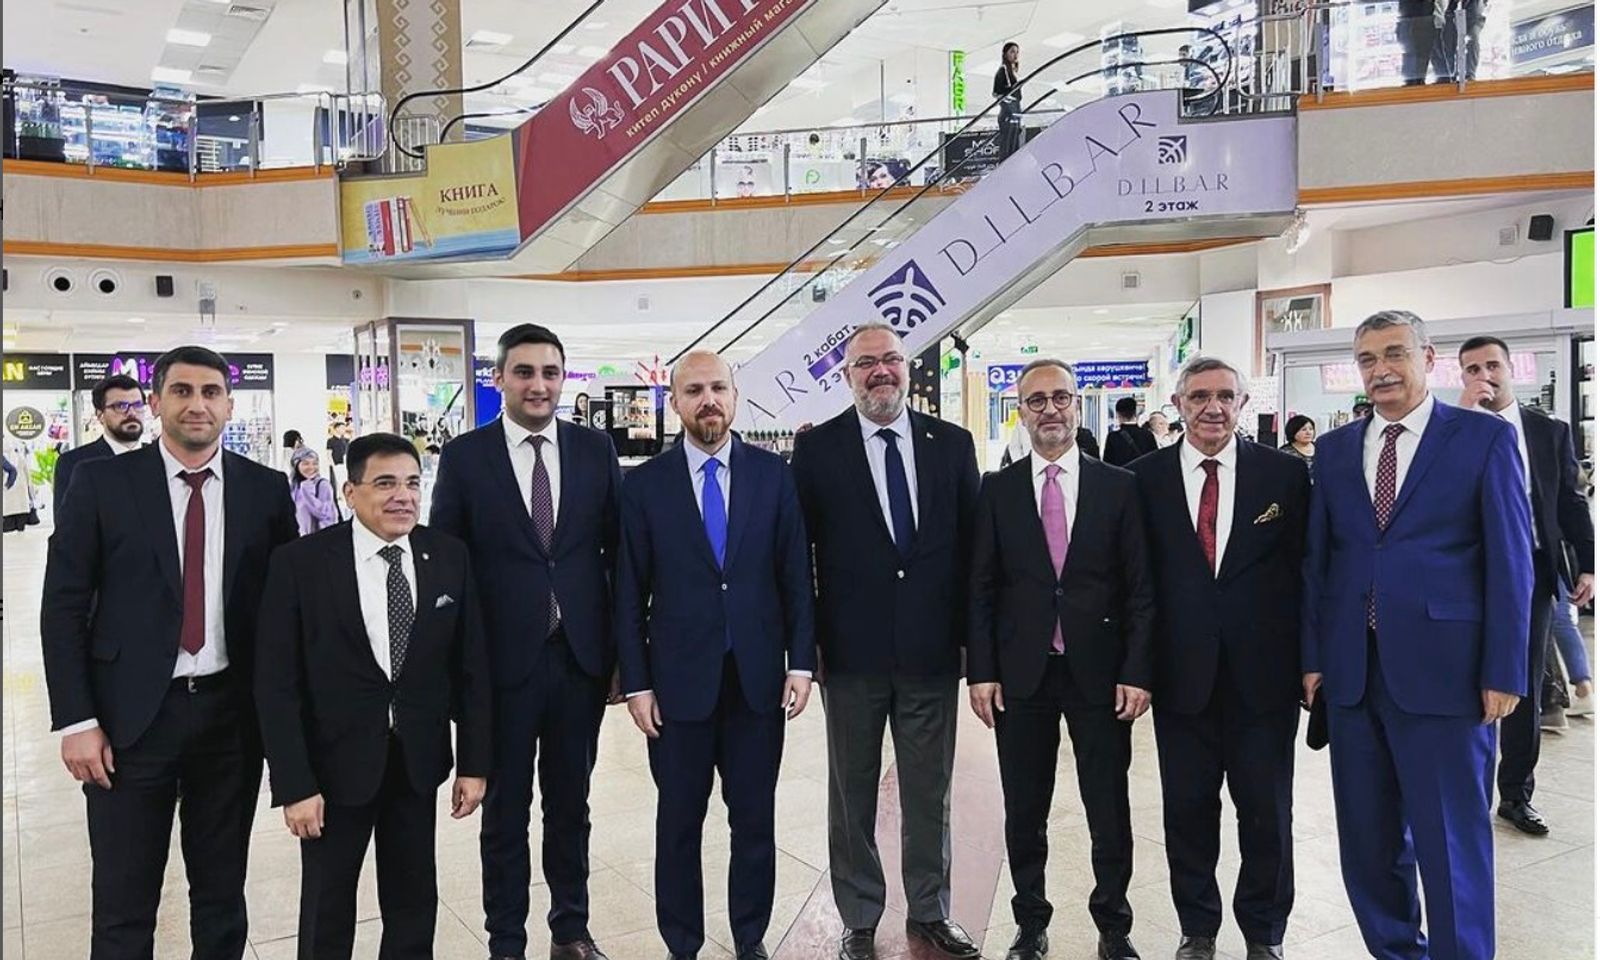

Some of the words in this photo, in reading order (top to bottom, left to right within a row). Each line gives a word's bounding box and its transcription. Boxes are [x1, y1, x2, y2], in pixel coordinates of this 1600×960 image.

[625, 108, 660, 138] китеп
[709, 18, 763, 69] книжный
[439, 183, 499, 203] КНИГА
[938, 102, 1156, 276] DILBAR
[1118, 173, 1229, 196] DILBAR
[1145, 200, 1154, 212] 2
[1158, 200, 1199, 212] этаж
[804, 354, 814, 366] 2
[814, 324, 850, 358] кабат
[747, 370, 808, 427] AR
[819, 378, 832, 392] 2
